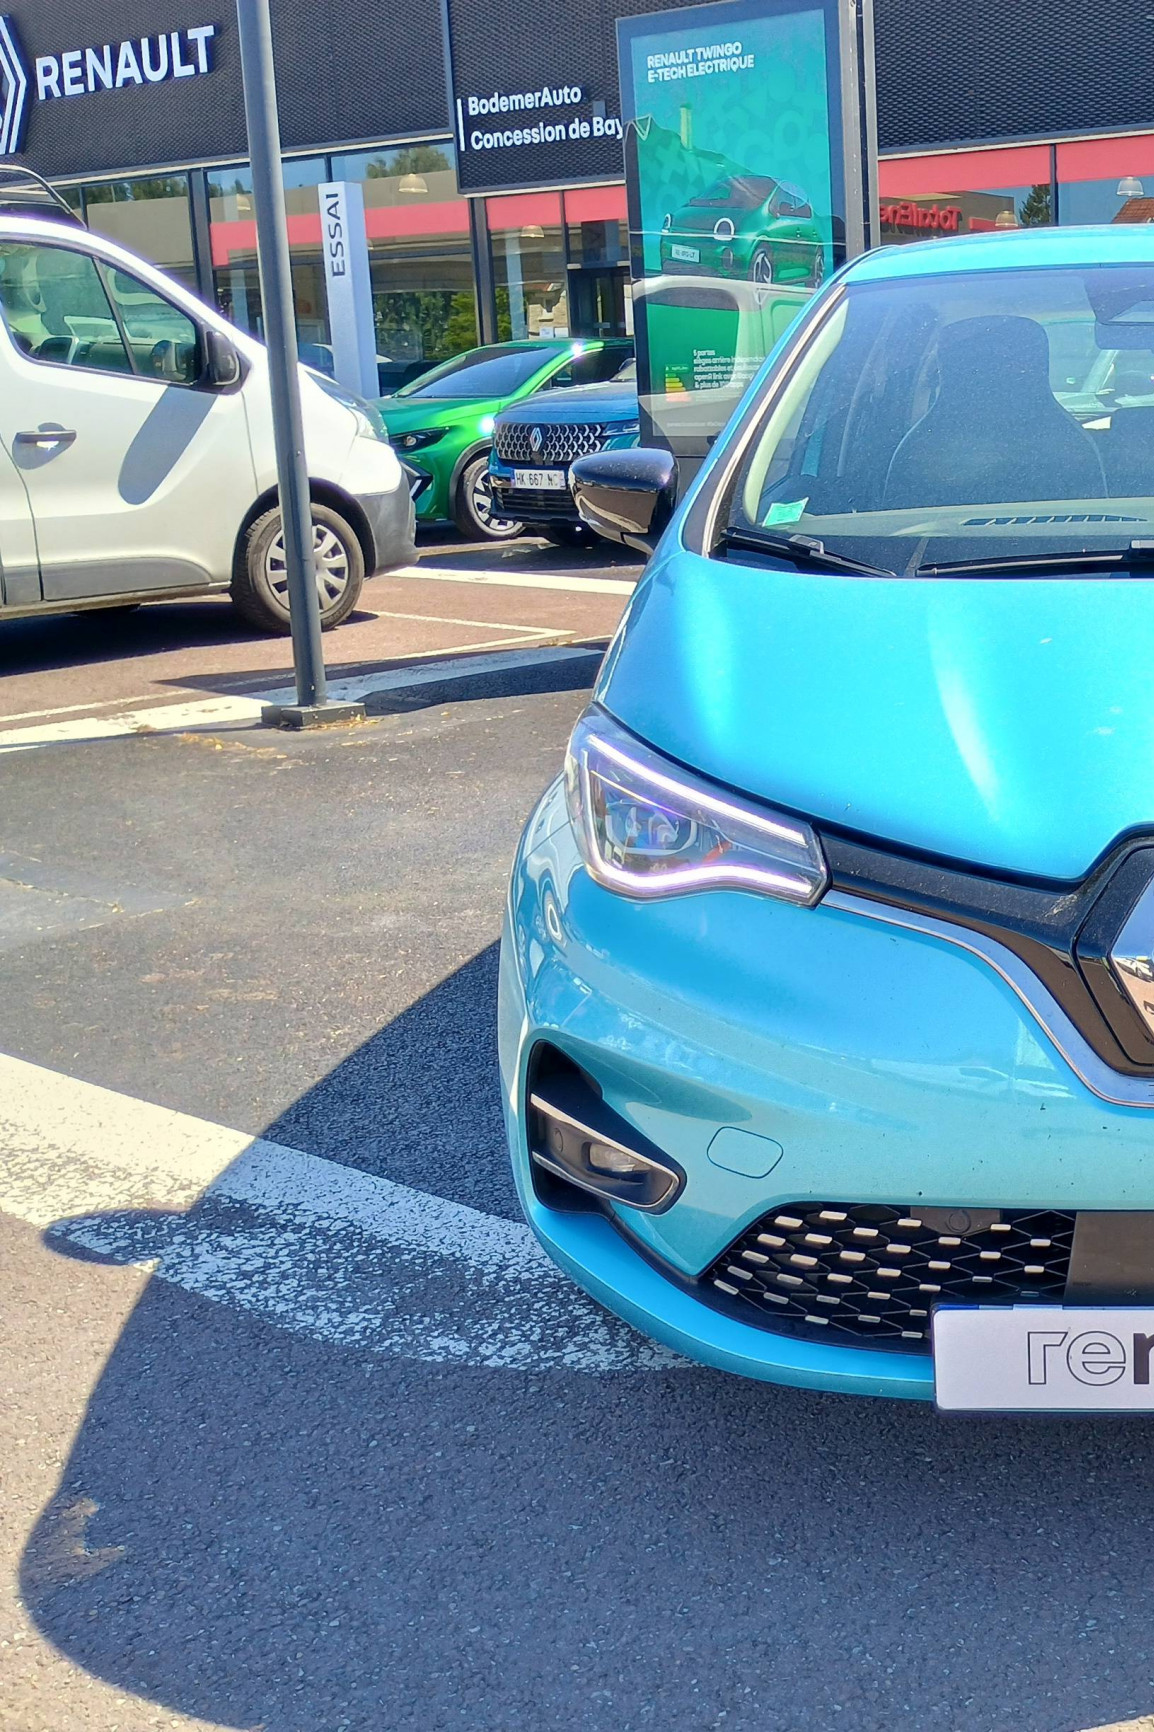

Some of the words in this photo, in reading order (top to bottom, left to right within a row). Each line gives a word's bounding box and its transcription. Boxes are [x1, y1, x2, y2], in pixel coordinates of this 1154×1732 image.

[35, 25, 215, 101] RENAULT
[647, 48, 695, 69] RENAULT
[695, 41, 742, 61] TWINGO
[647, 66, 687, 83] E-TECH
[687, 54, 755, 78] ELECTRIQUE
[468, 85, 582, 116] BodemerAuto
[470, 121, 566, 151] Concession
[568, 117, 591, 140] de
[325, 193, 346, 277] ESSAI
[529, 473, 543, 486] 667
